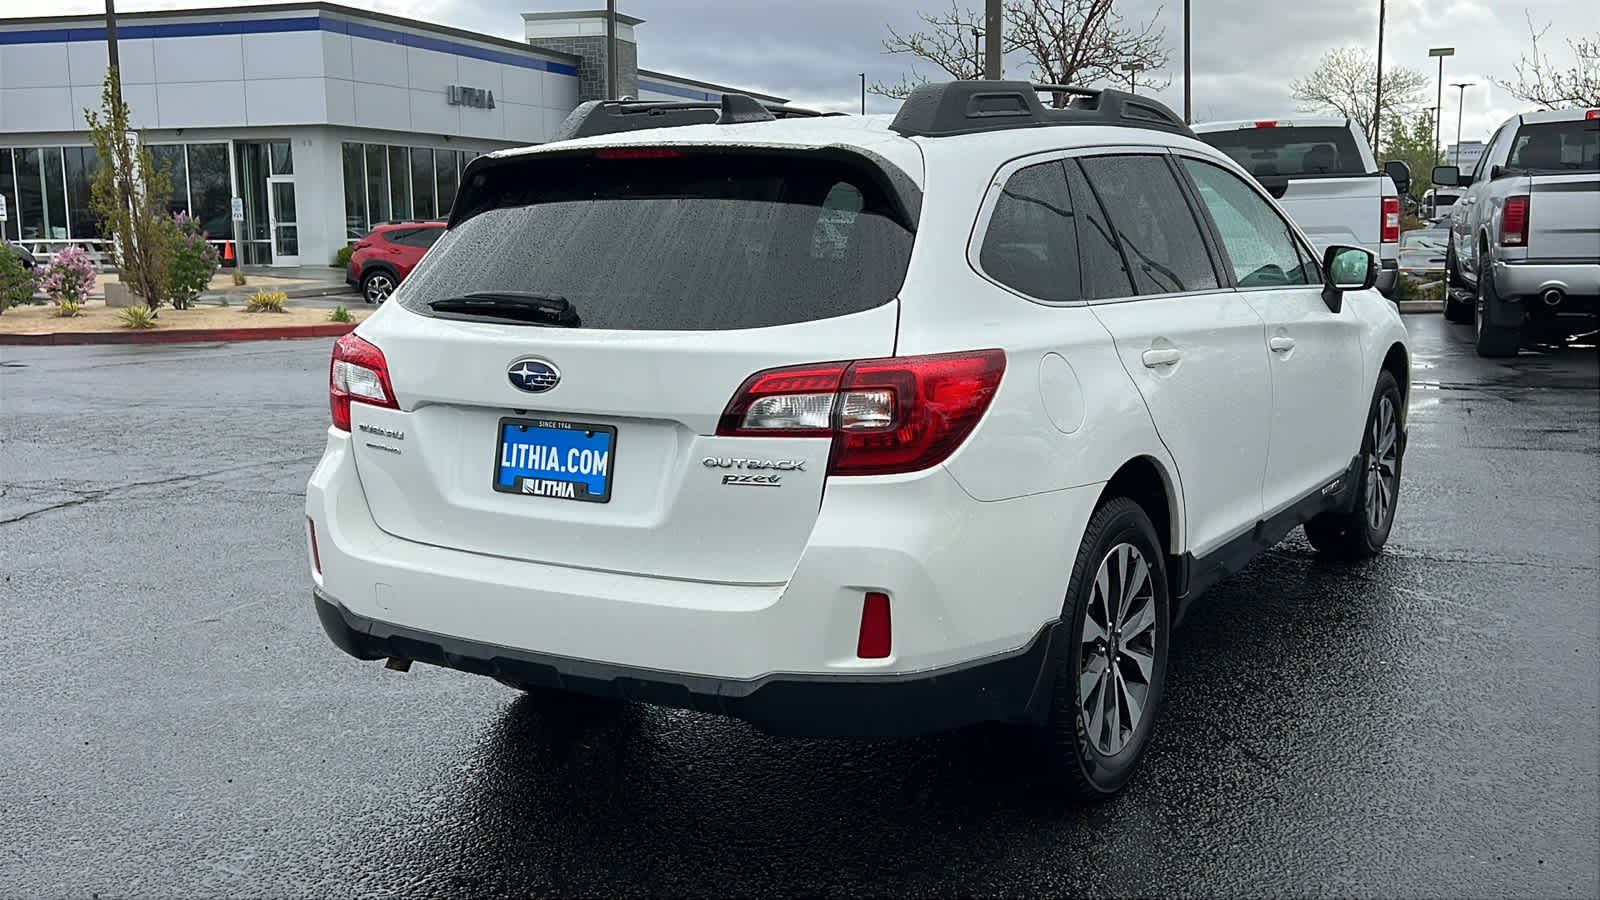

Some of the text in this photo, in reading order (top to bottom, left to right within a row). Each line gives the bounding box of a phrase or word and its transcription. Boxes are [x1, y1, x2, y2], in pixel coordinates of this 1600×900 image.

[447, 85, 496, 109] LITHIA
[538, 421, 557, 429] SINCE
[501, 442, 609, 477] LITHIA.COM
[702, 456, 807, 472] OUTBACK
[533, 479, 575, 499] LITHIA
